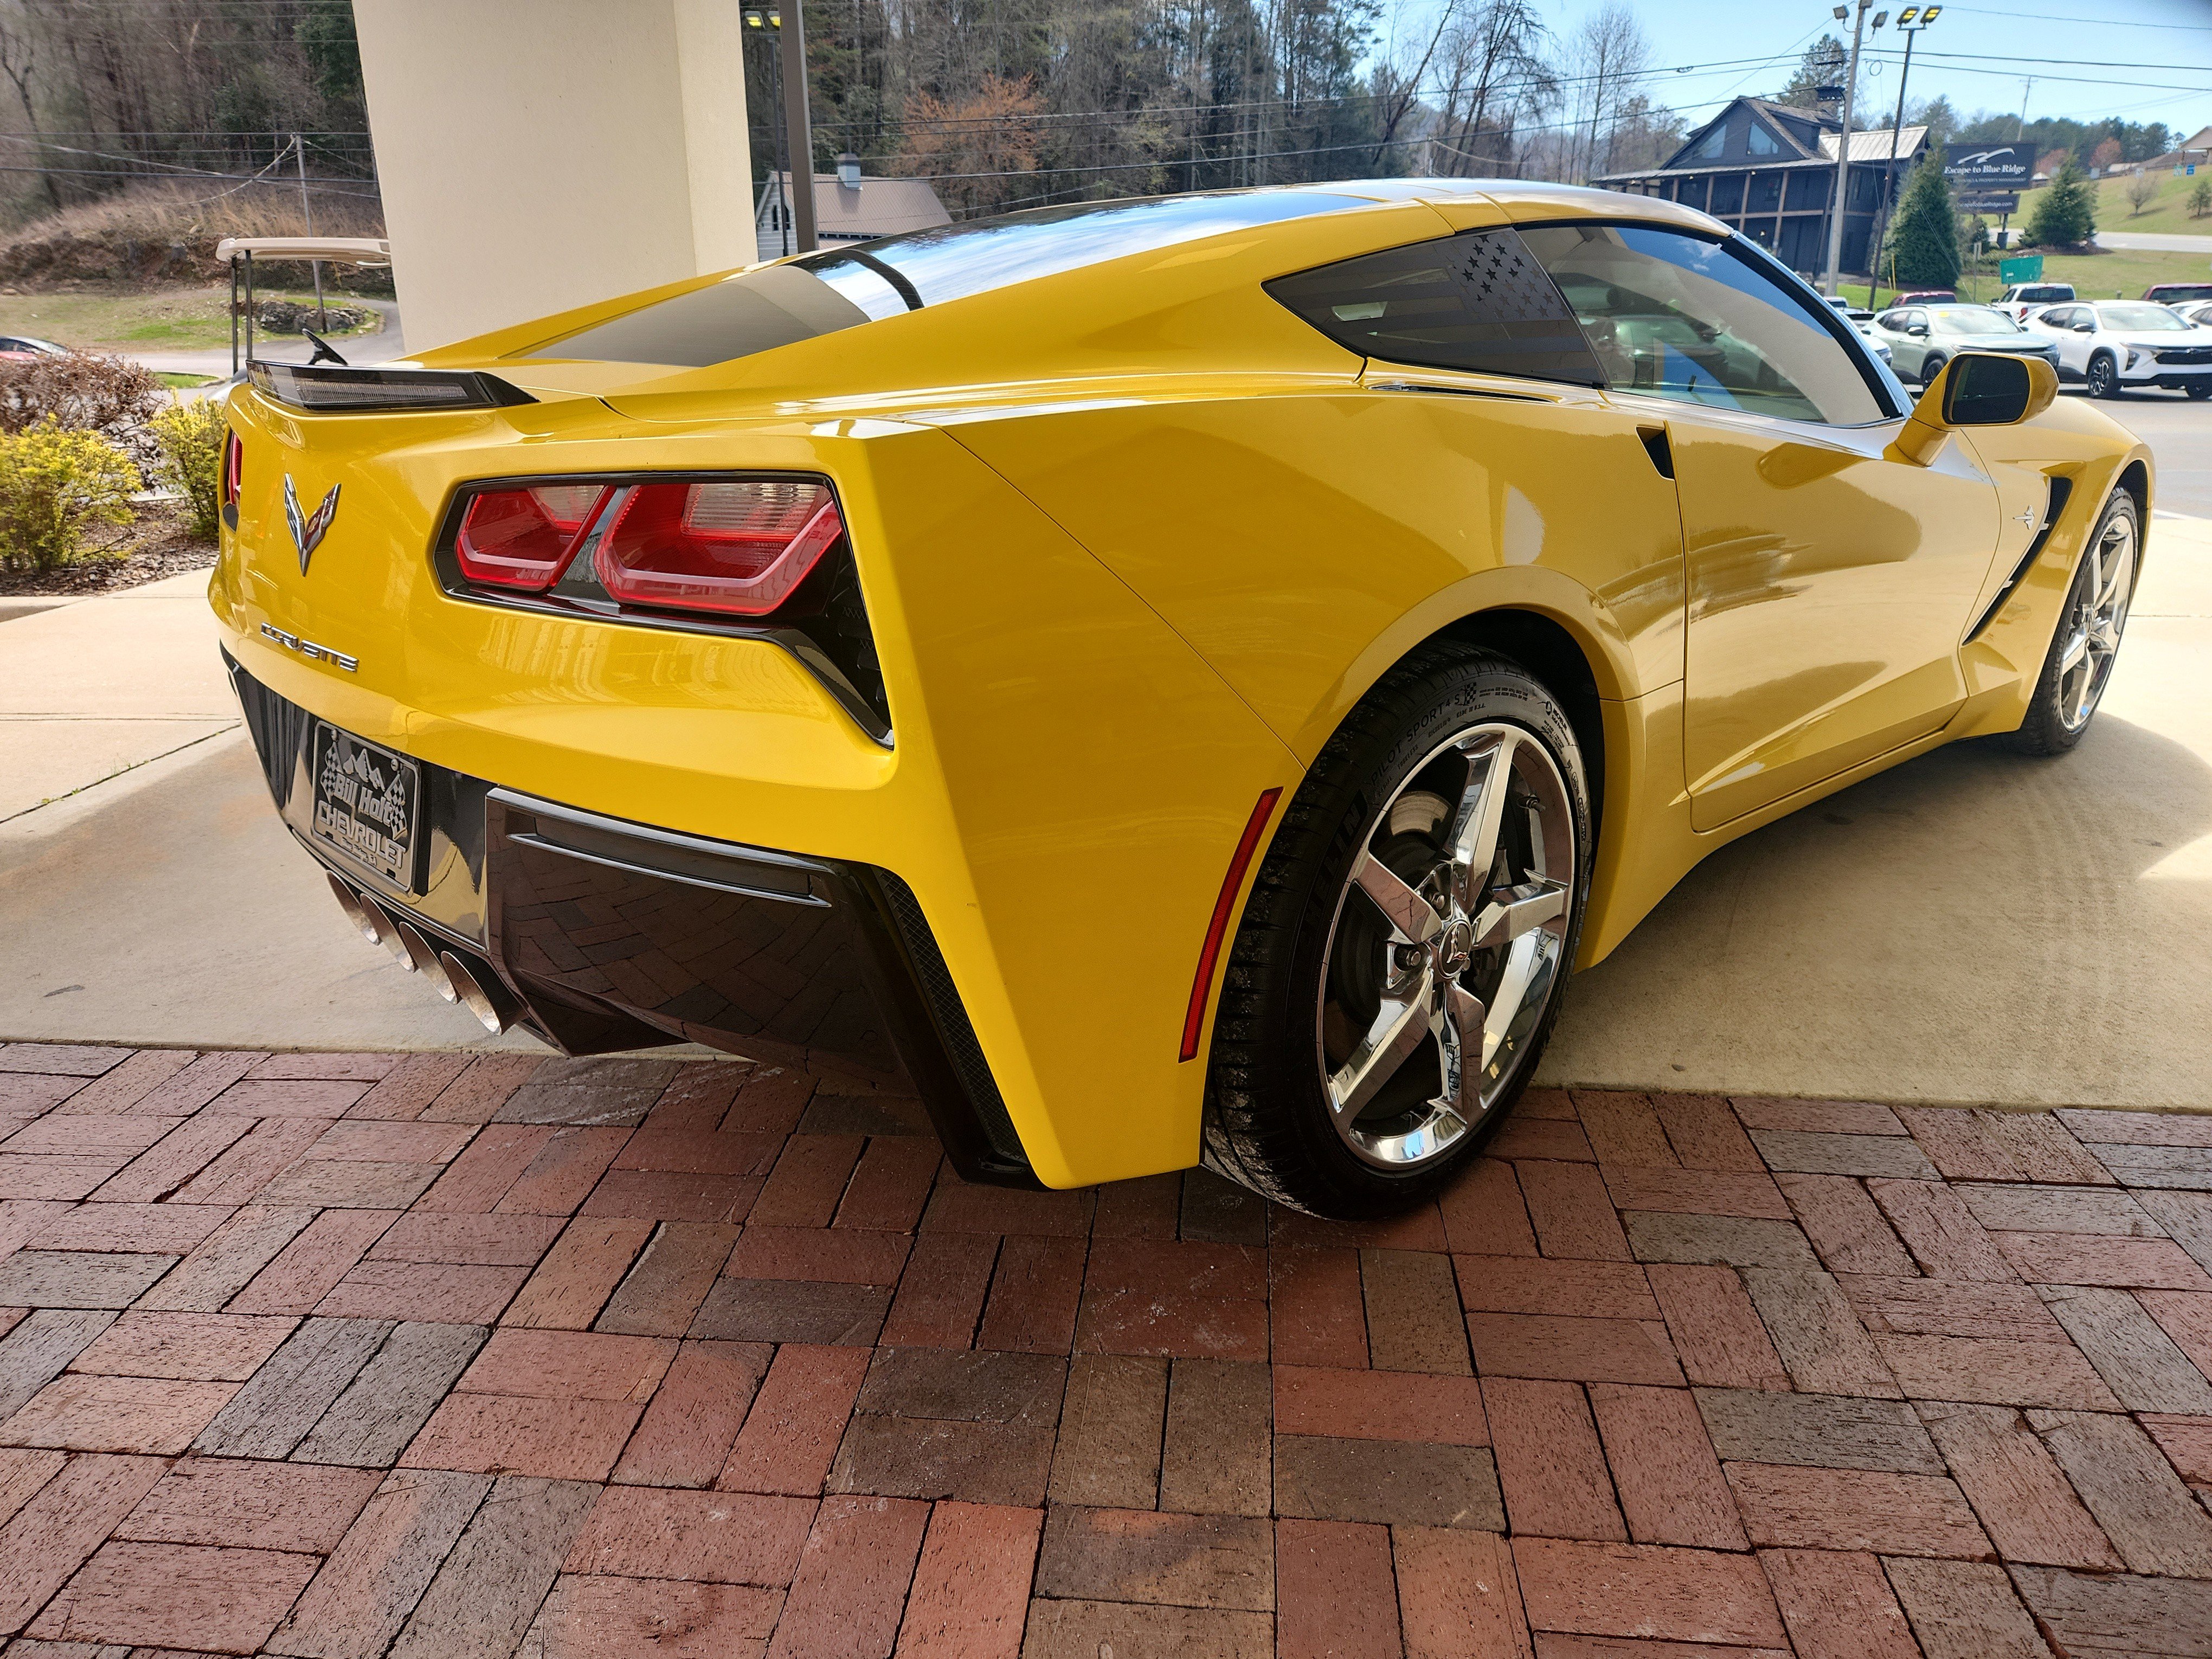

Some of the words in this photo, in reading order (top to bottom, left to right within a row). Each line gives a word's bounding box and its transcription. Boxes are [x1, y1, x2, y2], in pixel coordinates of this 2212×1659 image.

[1944, 166, 1972, 175] Escape
[1983, 165, 2001, 173] Blue
[2002, 164, 2026, 175] Ridge
[261, 622, 359, 672] CORVETTE
[1372, 739, 1401, 786] PILOT
[1406, 702, 1444, 742] SPORT
[1445, 698, 1451, 707] 4
[1454, 693, 1460, 705] S
[333, 773, 358, 806] Bill
[358, 786, 393, 827] Holt
[317, 800, 407, 869] CHEVROLET
